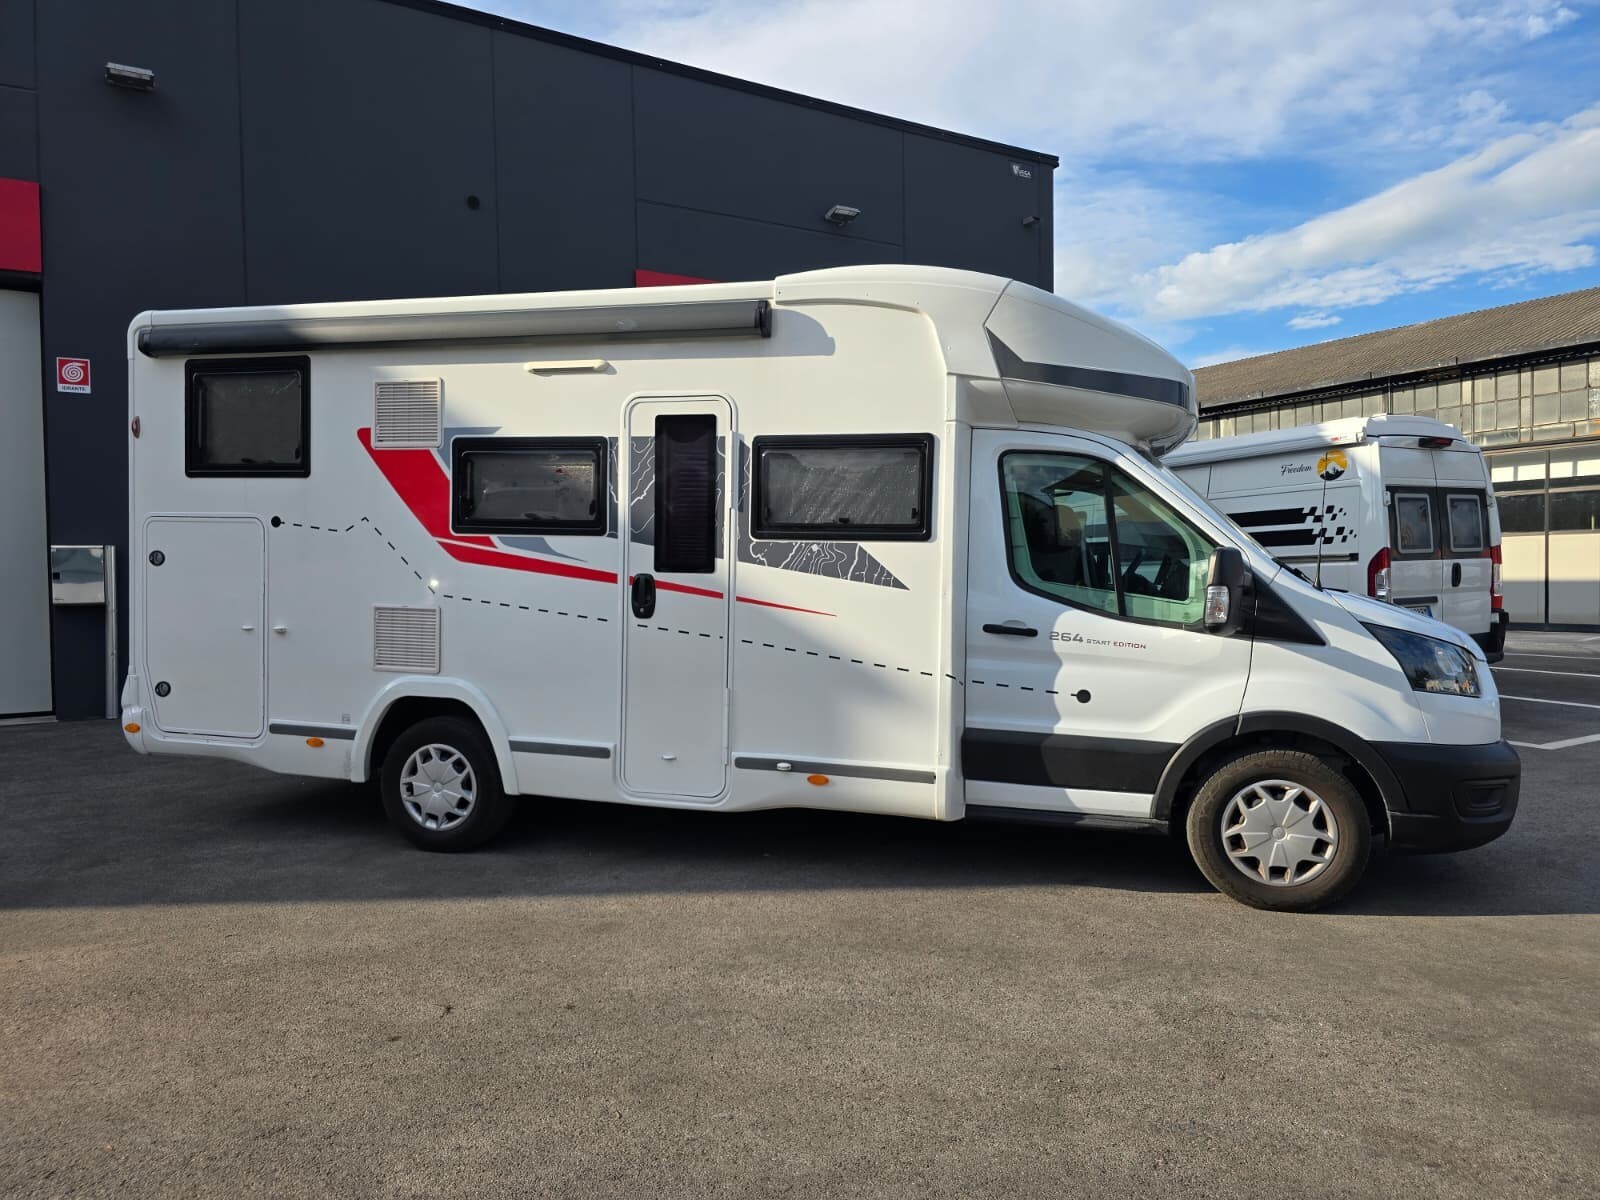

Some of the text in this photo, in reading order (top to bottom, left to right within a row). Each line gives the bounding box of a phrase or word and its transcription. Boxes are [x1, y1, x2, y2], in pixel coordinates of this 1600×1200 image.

[1281, 463, 1312, 476] Freedom
[1049, 631, 1084, 643] 264
[1113, 641, 1147, 649] EDITION
